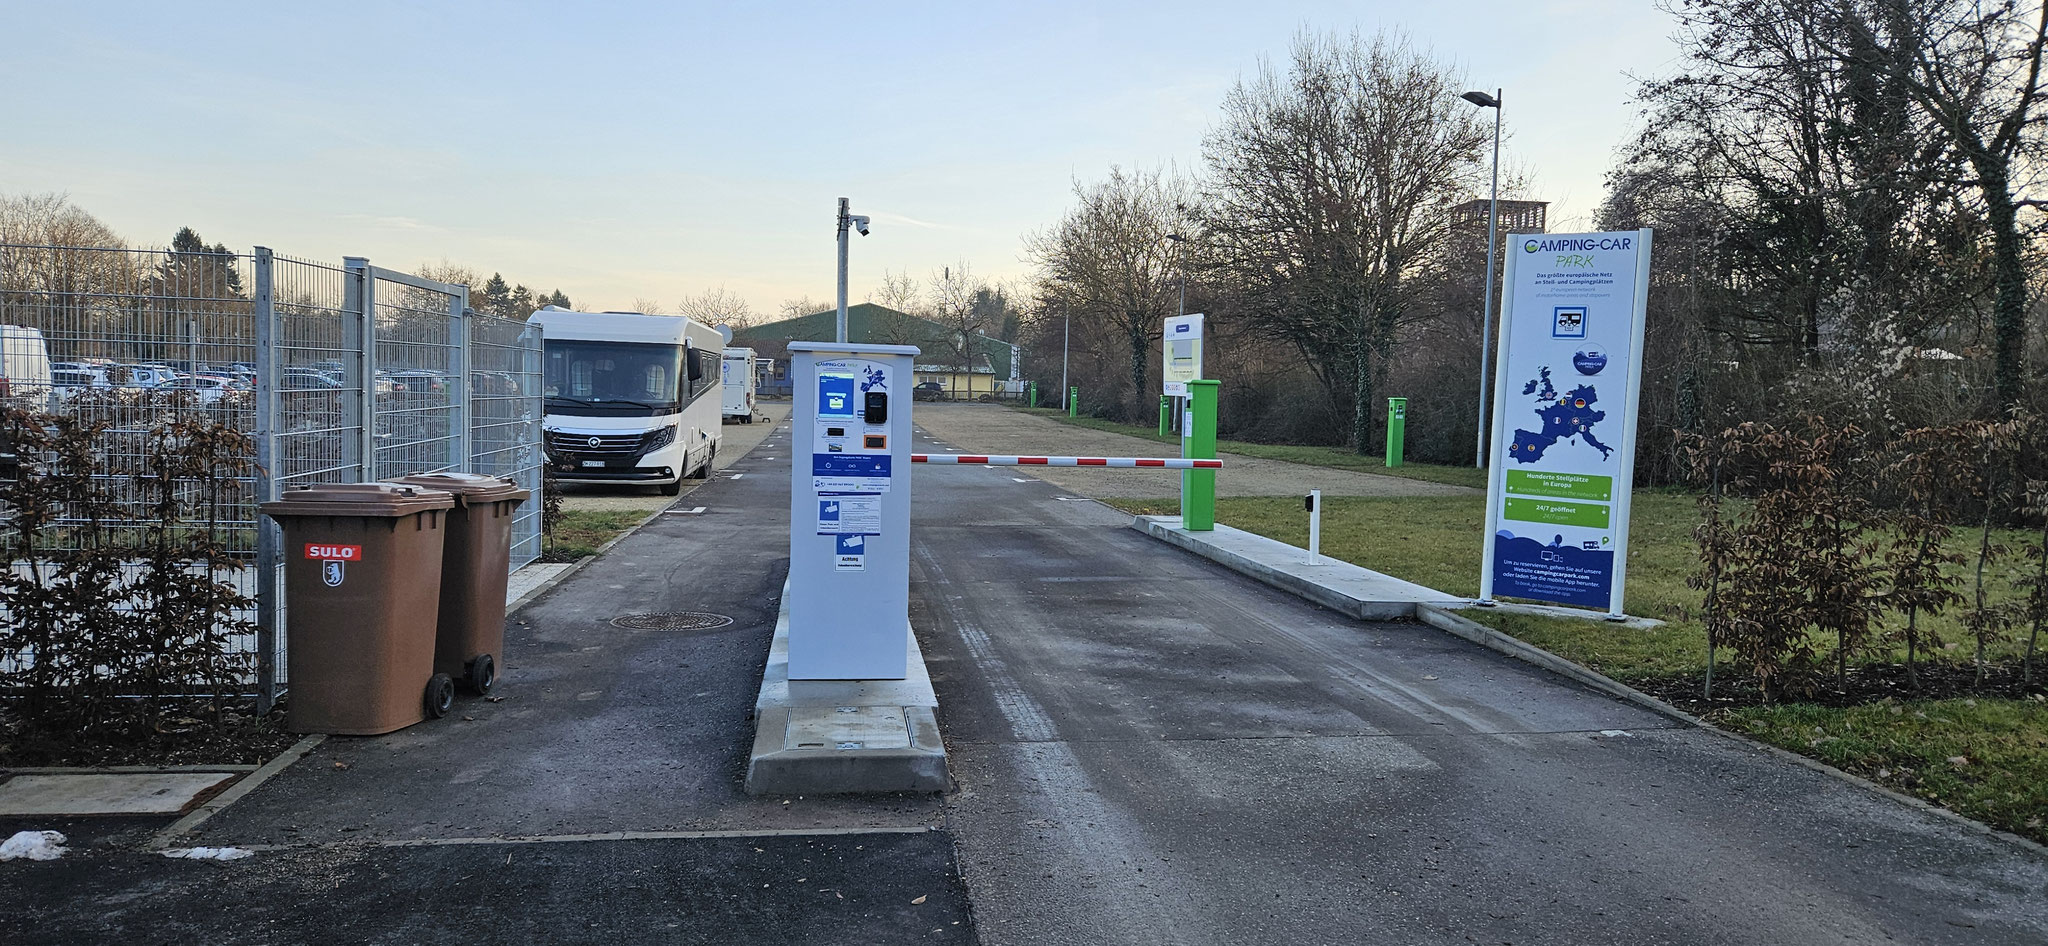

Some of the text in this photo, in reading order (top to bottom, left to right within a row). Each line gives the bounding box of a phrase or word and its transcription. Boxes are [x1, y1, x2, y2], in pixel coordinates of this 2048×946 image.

[1524, 238, 1631, 253] CAMPING-CAR
[1555, 254, 1595, 269] PARK
[1526, 472, 1589, 483] Hunderte Stellplätze
[1550, 481, 1572, 489] Europa
[1550, 505, 1576, 513] geöffnet
[309, 546, 353, 558] SULO
[1520, 561, 1549, 569] reservieren,
[1533, 568, 1590, 580] campingcarpark.com
[1564, 578, 1576, 586] App
[1576, 580, 1600, 588] herunter.
